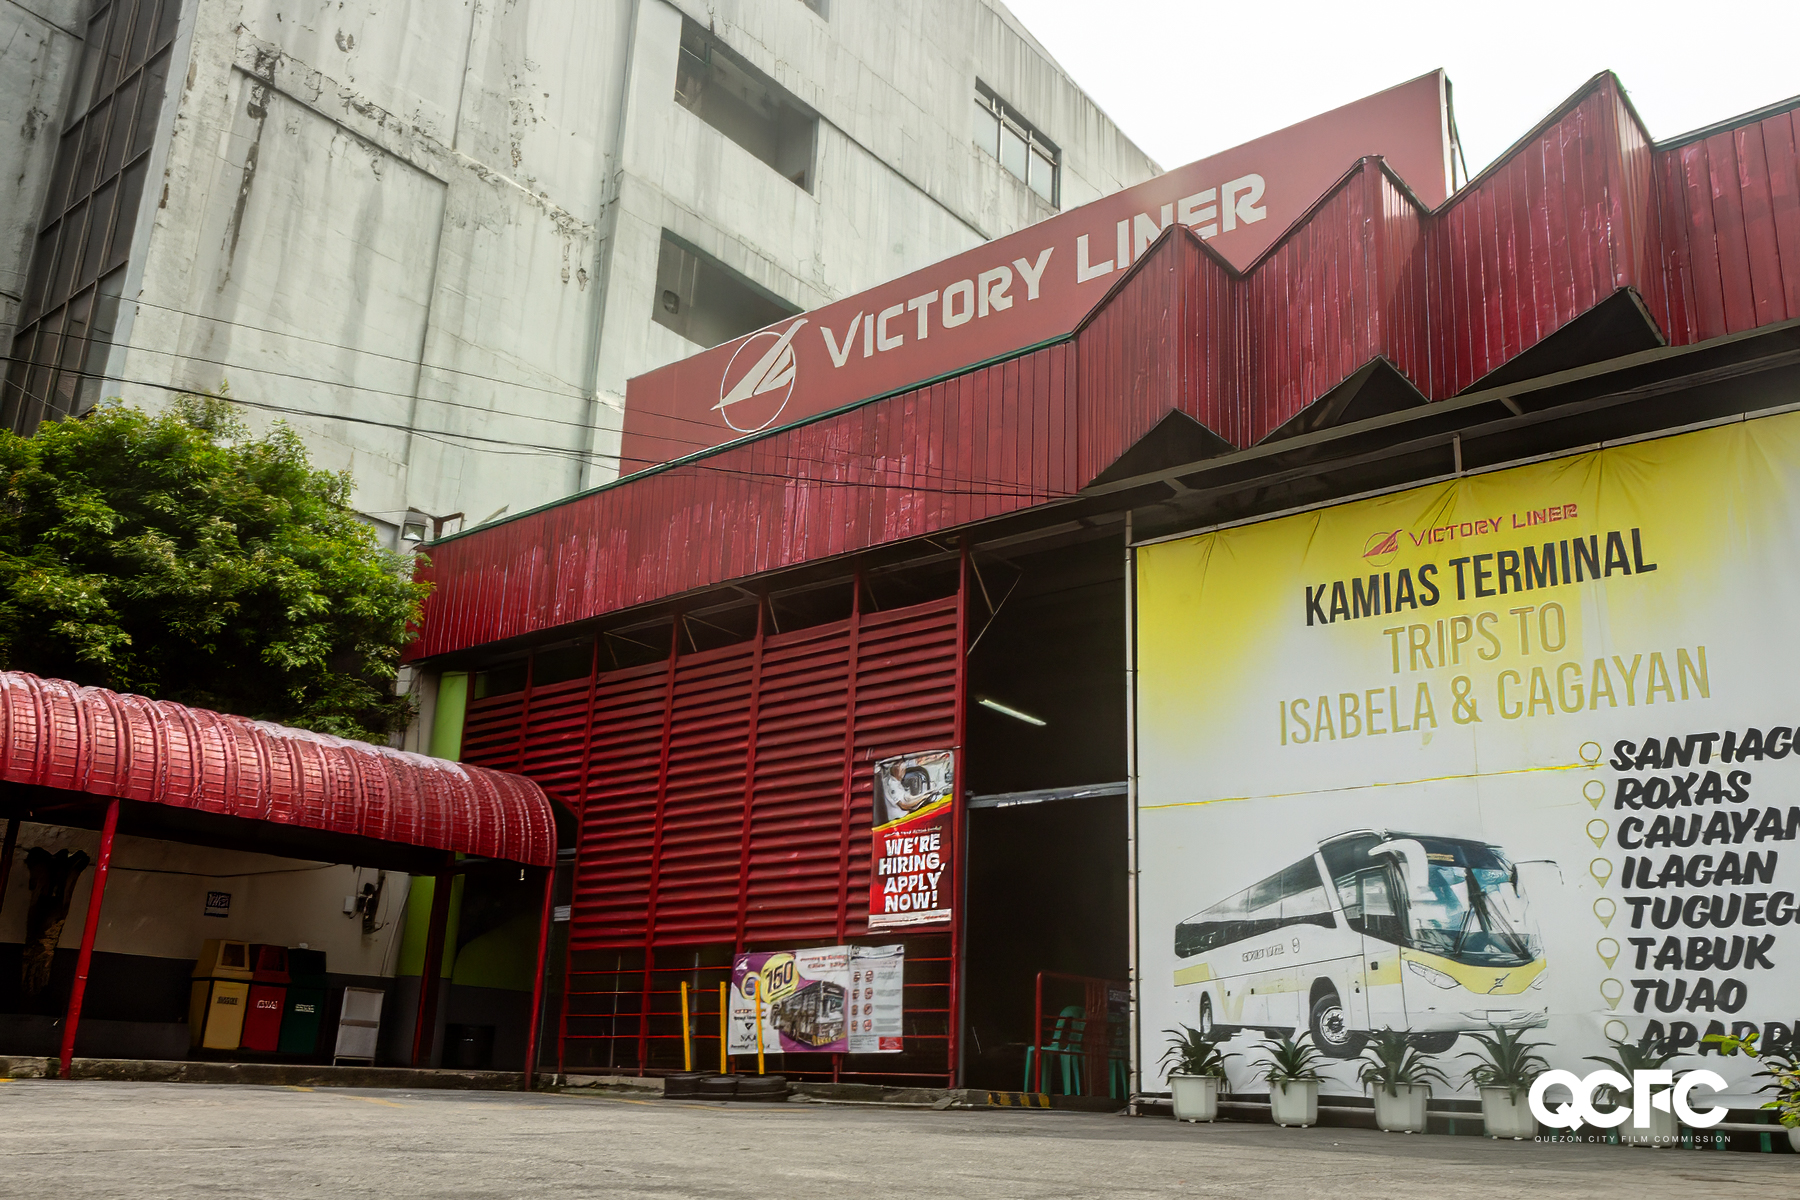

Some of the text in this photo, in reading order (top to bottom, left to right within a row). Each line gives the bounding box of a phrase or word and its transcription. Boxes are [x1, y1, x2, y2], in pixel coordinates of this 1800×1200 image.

[820, 173, 1267, 368] VICTORY LINER
[1409, 503, 1578, 547] VICTORY LINER
[1306, 528, 1658, 627] KAMIAS TERMINAL
[1383, 602, 1566, 674] TRIPS TO
[1279, 645, 1711, 746] ISABELA & CAGAYAN
[1614, 770, 1751, 810] ROXAS
[878, 852, 946, 875] HIRING,
[885, 833, 941, 857] WE'RE
[883, 871, 942, 894] APPLY
[1621, 850, 1778, 889] ILAGAN
[884, 890, 938, 912] NOW!
[1623, 891, 1800, 929] TUGUEG
[1628, 934, 1776, 971] TABUK
[1630, 977, 1747, 1014] TUAO
